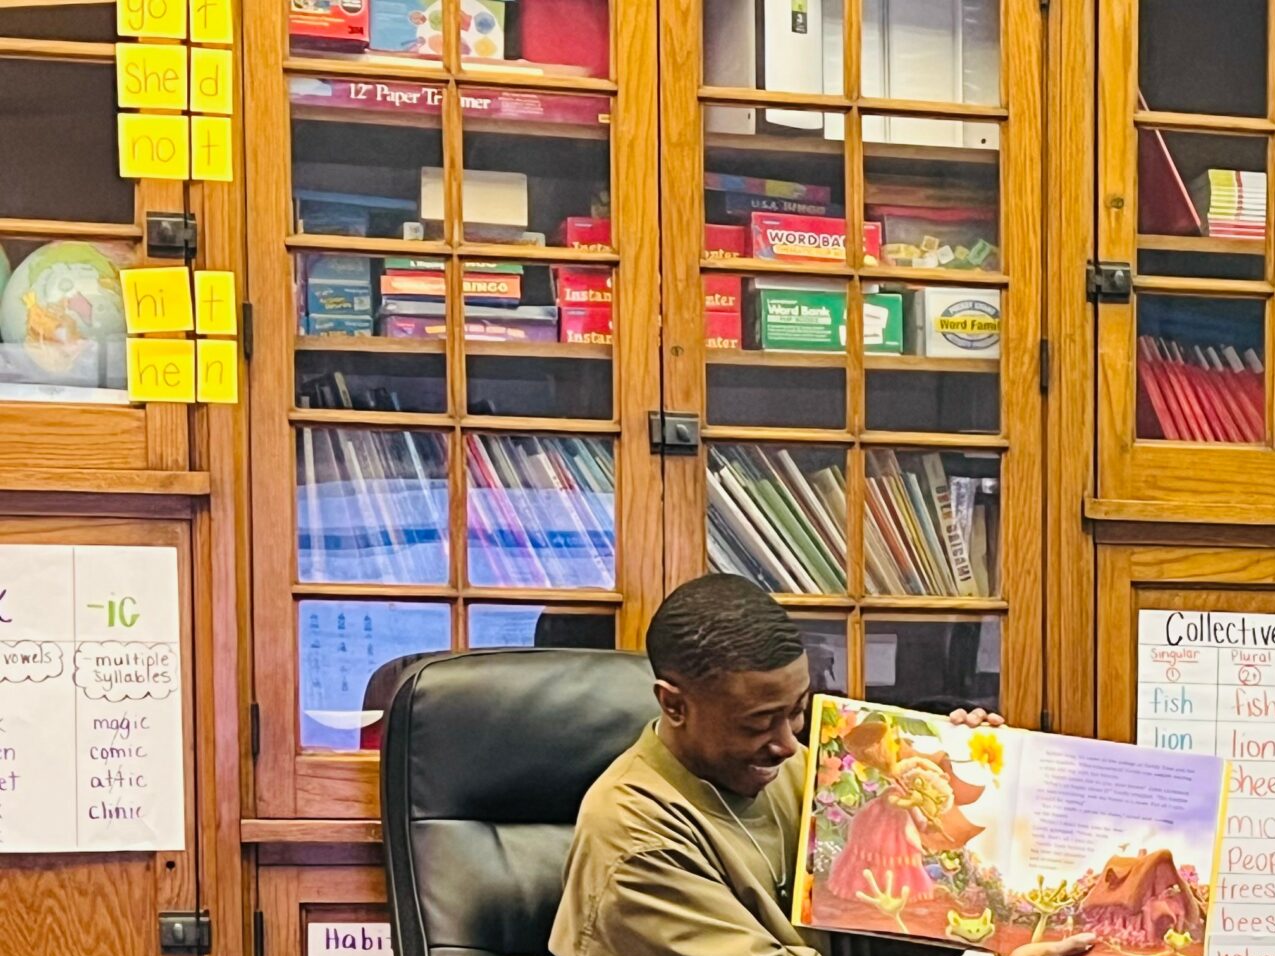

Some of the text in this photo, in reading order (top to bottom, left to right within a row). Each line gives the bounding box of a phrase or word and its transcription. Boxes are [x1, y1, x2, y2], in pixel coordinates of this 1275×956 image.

[200, 64, 218, 96] d
[376, 84, 420, 106] Paper
[132, 130, 220, 166] no t
[769, 231, 817, 245] WORD
[134, 282, 224, 322] hi t
[767, 304, 830, 316] Word Bank
[940, 320, 967, 330] Word
[138, 348, 223, 387] he n
[4, 646, 52, 665] vowels
[1150, 648, 1200, 666] Singular
[1231, 650, 1272, 663] Plural
[92, 670, 172, 692] syllables
[1149, 686, 1193, 714] fish
[93, 716, 150, 740] magic
[1154, 726, 1193, 750] lion
[90, 744, 148, 760] comic
[90, 770, 148, 789] attic
[88, 801, 144, 820] clinic
